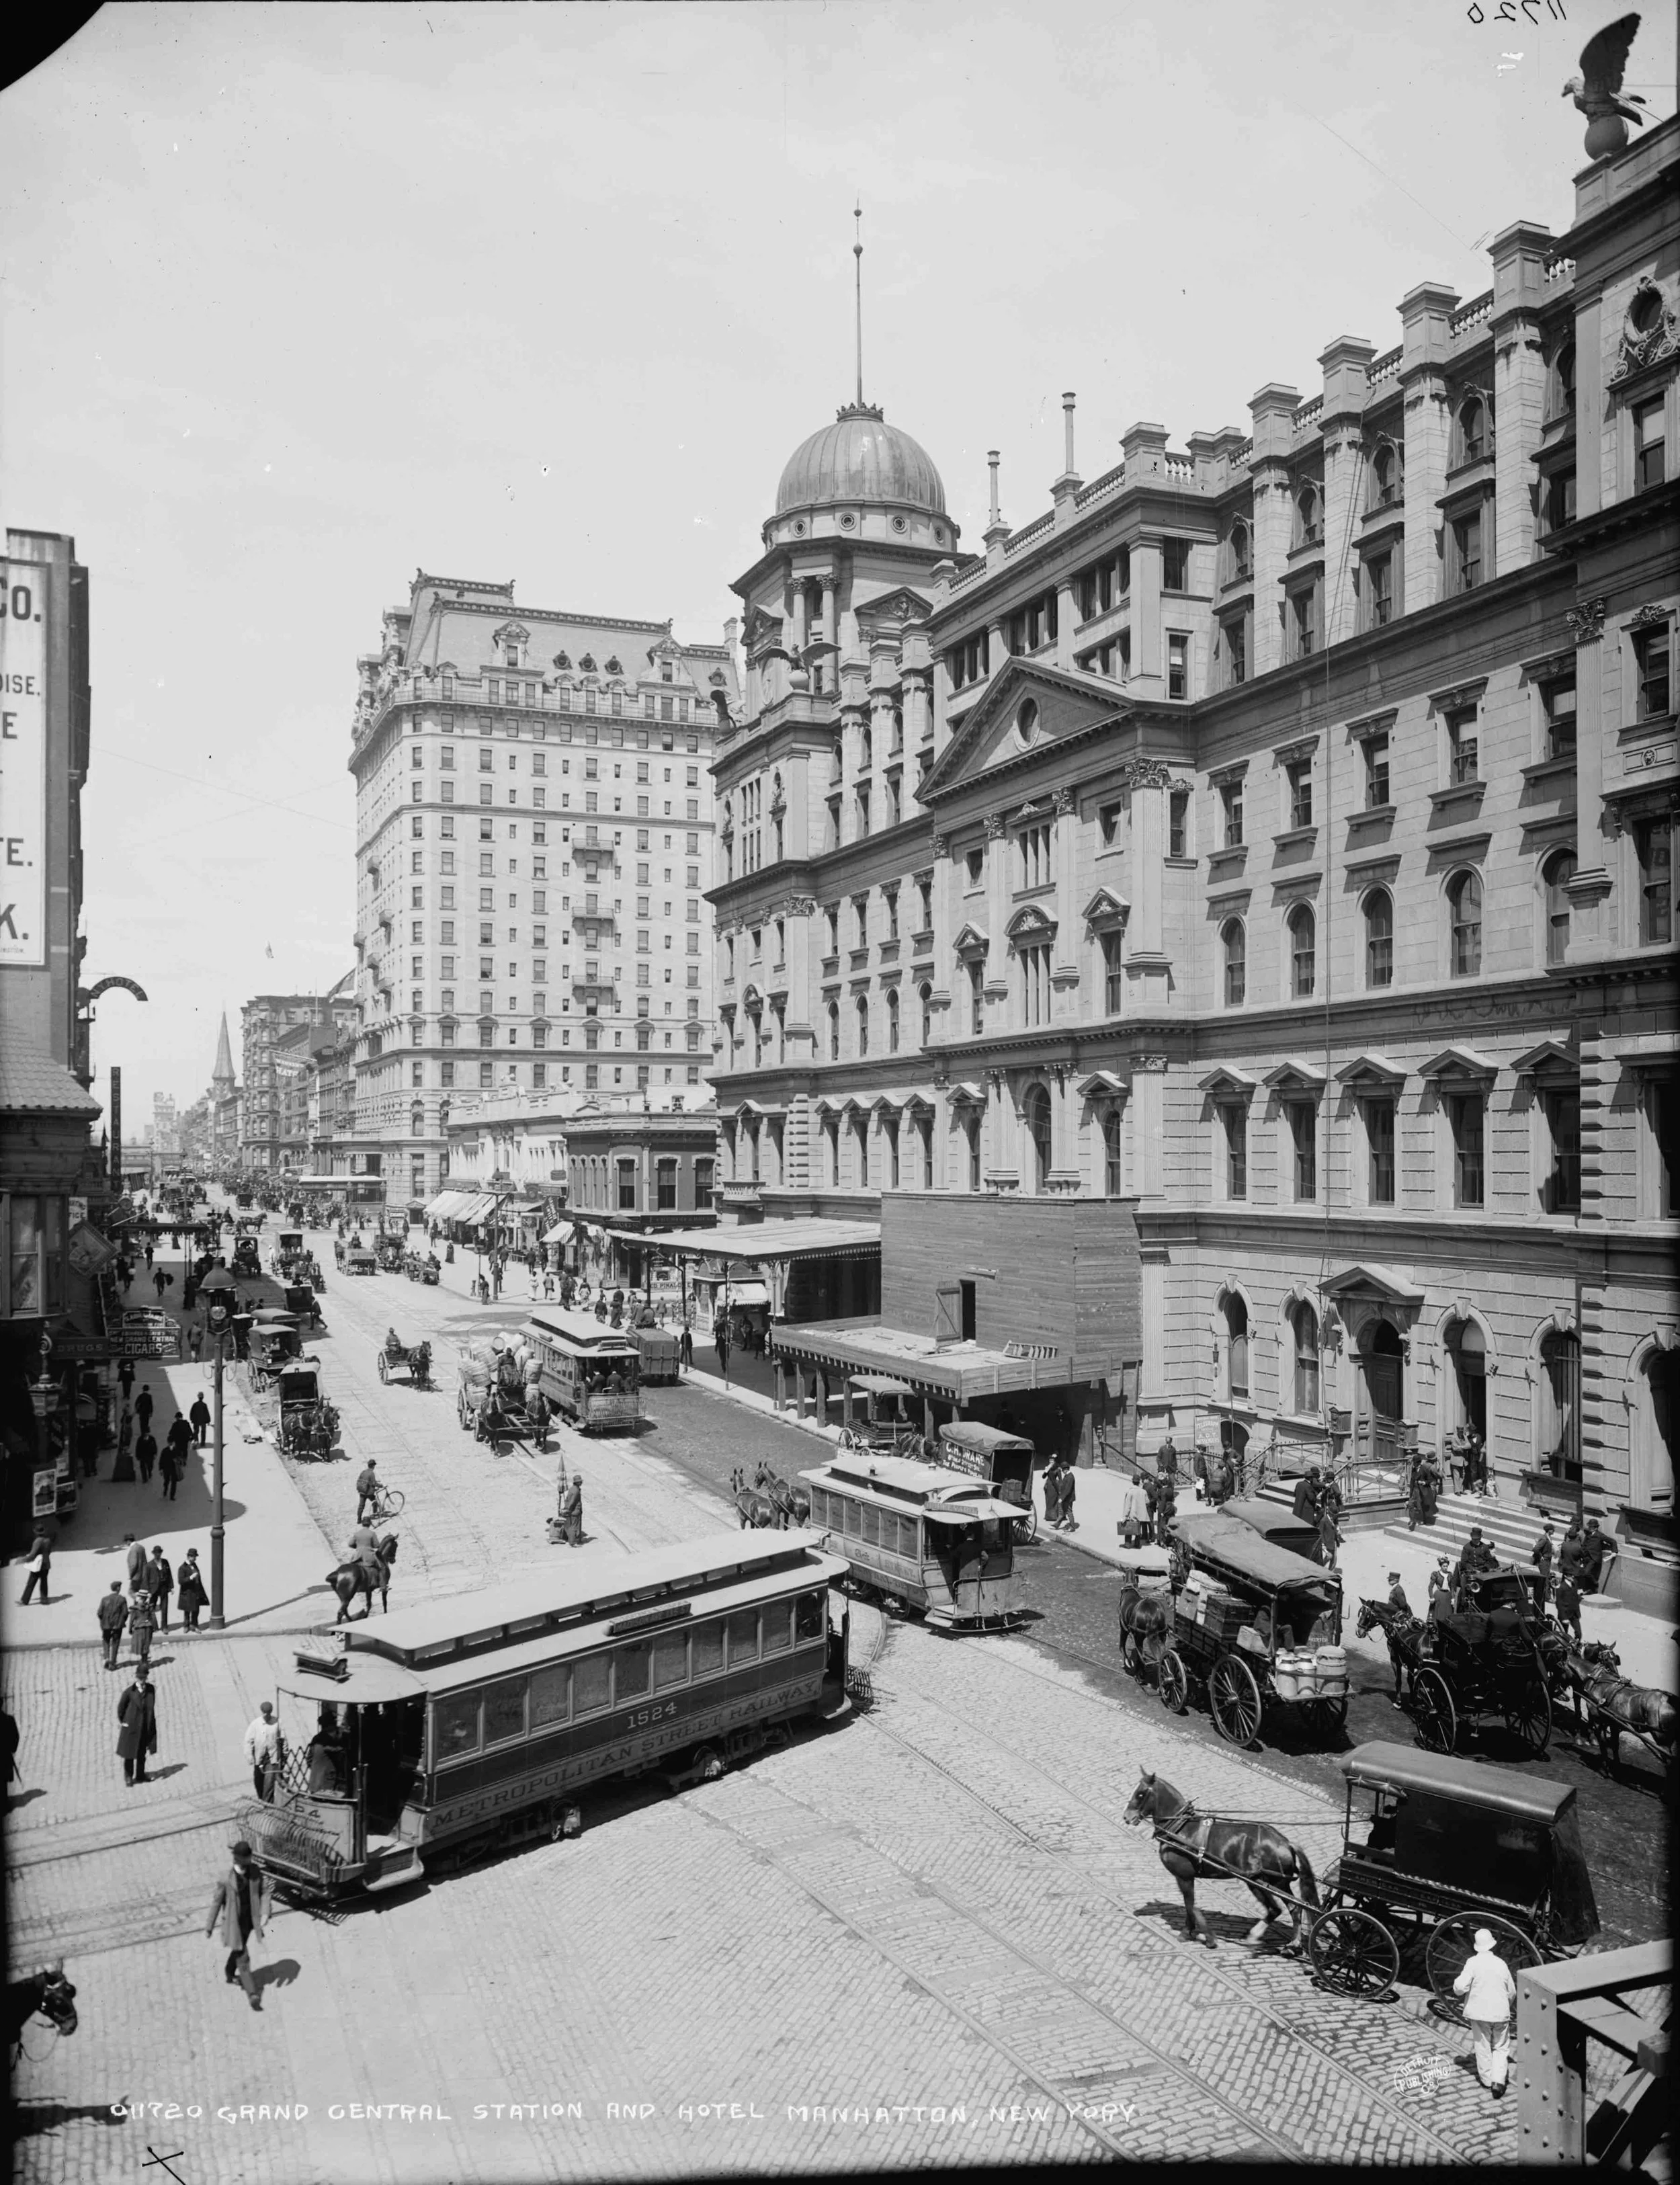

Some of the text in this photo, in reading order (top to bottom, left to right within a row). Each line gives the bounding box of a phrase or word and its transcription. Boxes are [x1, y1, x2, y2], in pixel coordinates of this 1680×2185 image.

[112, 1068, 120, 1189] RESTAURANT
[56, 1344, 103, 1353] DRUGS
[125, 1344, 162, 1354] CIGARS
[962, 1447, 984, 1466] DRAKE
[627, 1702, 677, 1731] 1524
[433, 1681, 816, 1827] METROPOLITAN STREET RAILWAY
